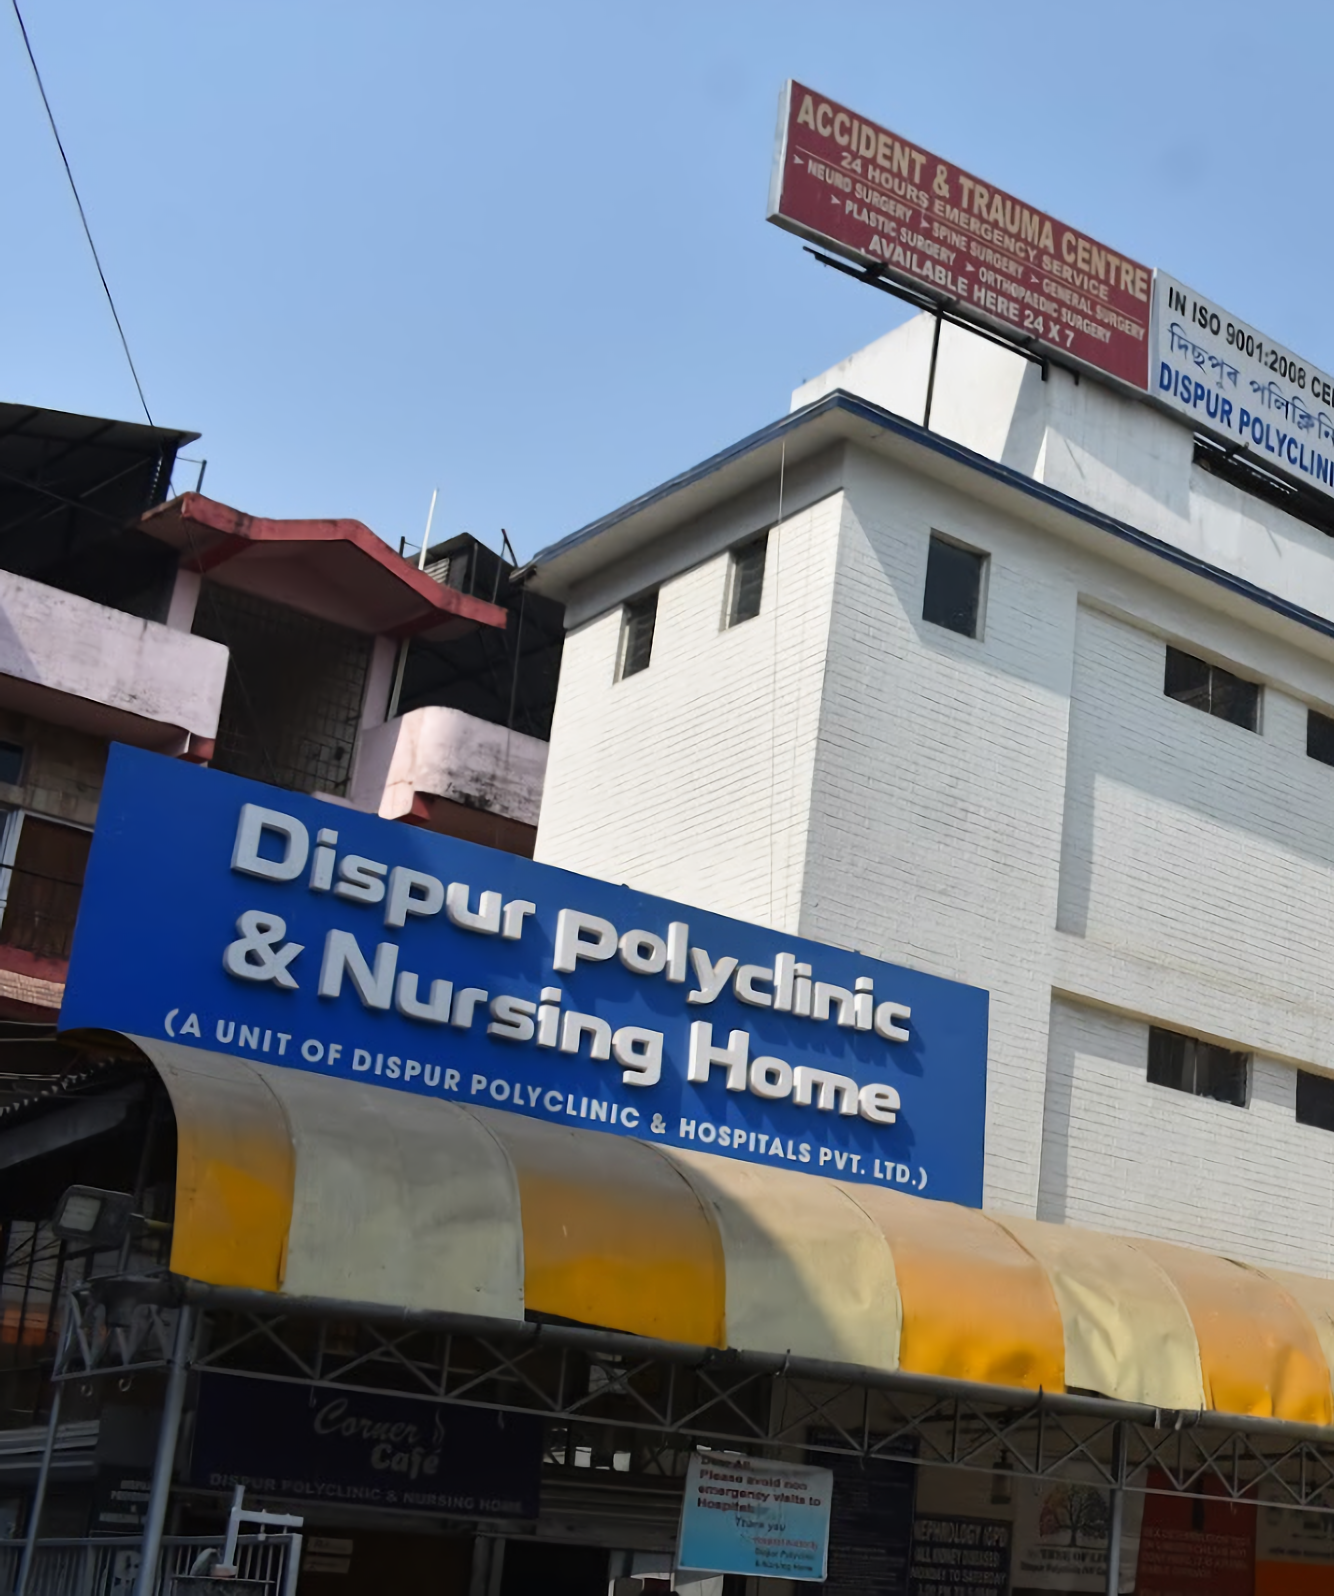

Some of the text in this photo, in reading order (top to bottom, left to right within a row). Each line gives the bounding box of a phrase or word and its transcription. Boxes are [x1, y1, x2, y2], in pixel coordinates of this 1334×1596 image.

[797, 94, 1148, 303] ACCIDENT & TRAUMA CENTRE
[807, 158, 1146, 341] NEURO SURGERY SPINE SURGERY GENERAL SURGERY
[841, 151, 1109, 301] 24 HOURS EMERGENCY SERVICE
[845, 199, 1112, 344] PLASTIC SURGERY ORTHOPAEDIC SURGERY
[868, 234, 1075, 348] AVAILABLE HERE 24 X 7
[1158, 360, 1233, 429] DISPUR
[1168, 286, 1187, 317] IN
[1191, 301, 1222, 336] ISO
[1225, 322, 1307, 390] 9001:2008
[230, 802, 536, 941] Dispur
[222, 909, 902, 1125] & Nursing Home
[164, 1008, 929, 1191] (A UNIT OF DISPUR POLYCLINIC & HOSPITALS PVT. LTD.)
[313, 1397, 423, 1445] Corner
[370, 1443, 442, 1481] Café
[700, 1468, 743, 1484] Please
[746, 1475, 781, 1488] avoid
[209, 1472, 278, 1492] DISPUR
[281, 1480, 381, 1502] POLYCLINIC
[386, 1490, 400, 1503] &
[403, 1491, 475, 1511] NURSING
[698, 1485, 770, 1503] emergency
[808, 1496, 821, 1507] to
